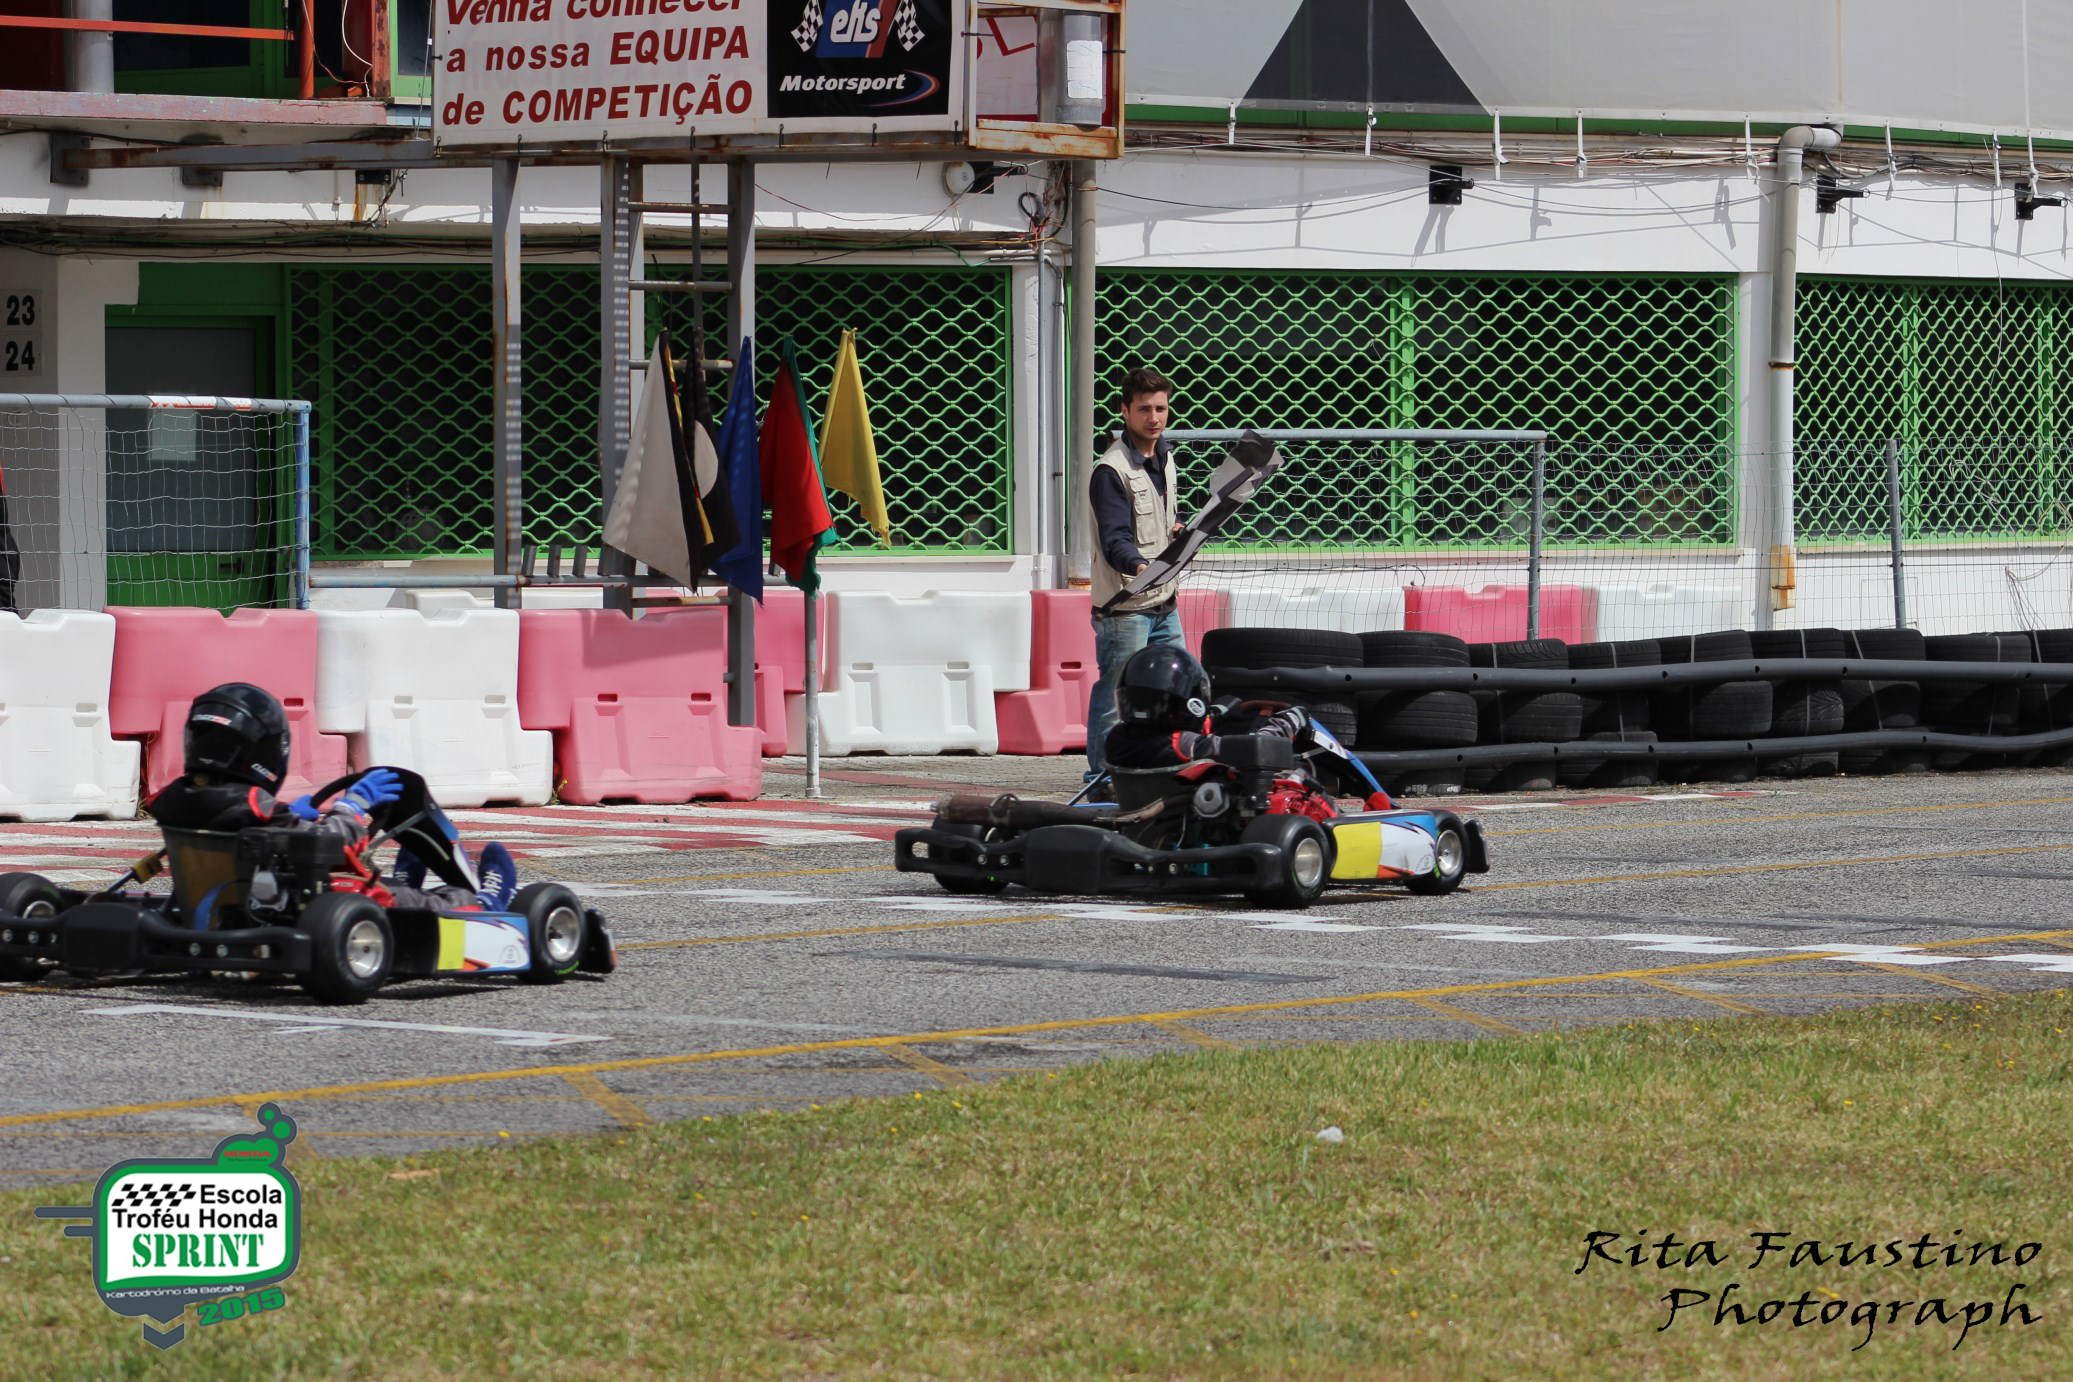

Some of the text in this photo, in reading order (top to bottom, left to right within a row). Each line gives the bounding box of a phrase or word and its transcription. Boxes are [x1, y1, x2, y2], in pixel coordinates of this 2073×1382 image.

[447, 0, 552, 25] Venha
[446, 25, 750, 72] a nossa EQUIPA
[442, 73, 753, 126] de COMPETIÇÃO
[779, 73, 906, 95] Motorsport
[6, 294, 36, 327] 23
[5, 340, 36, 372] 24
